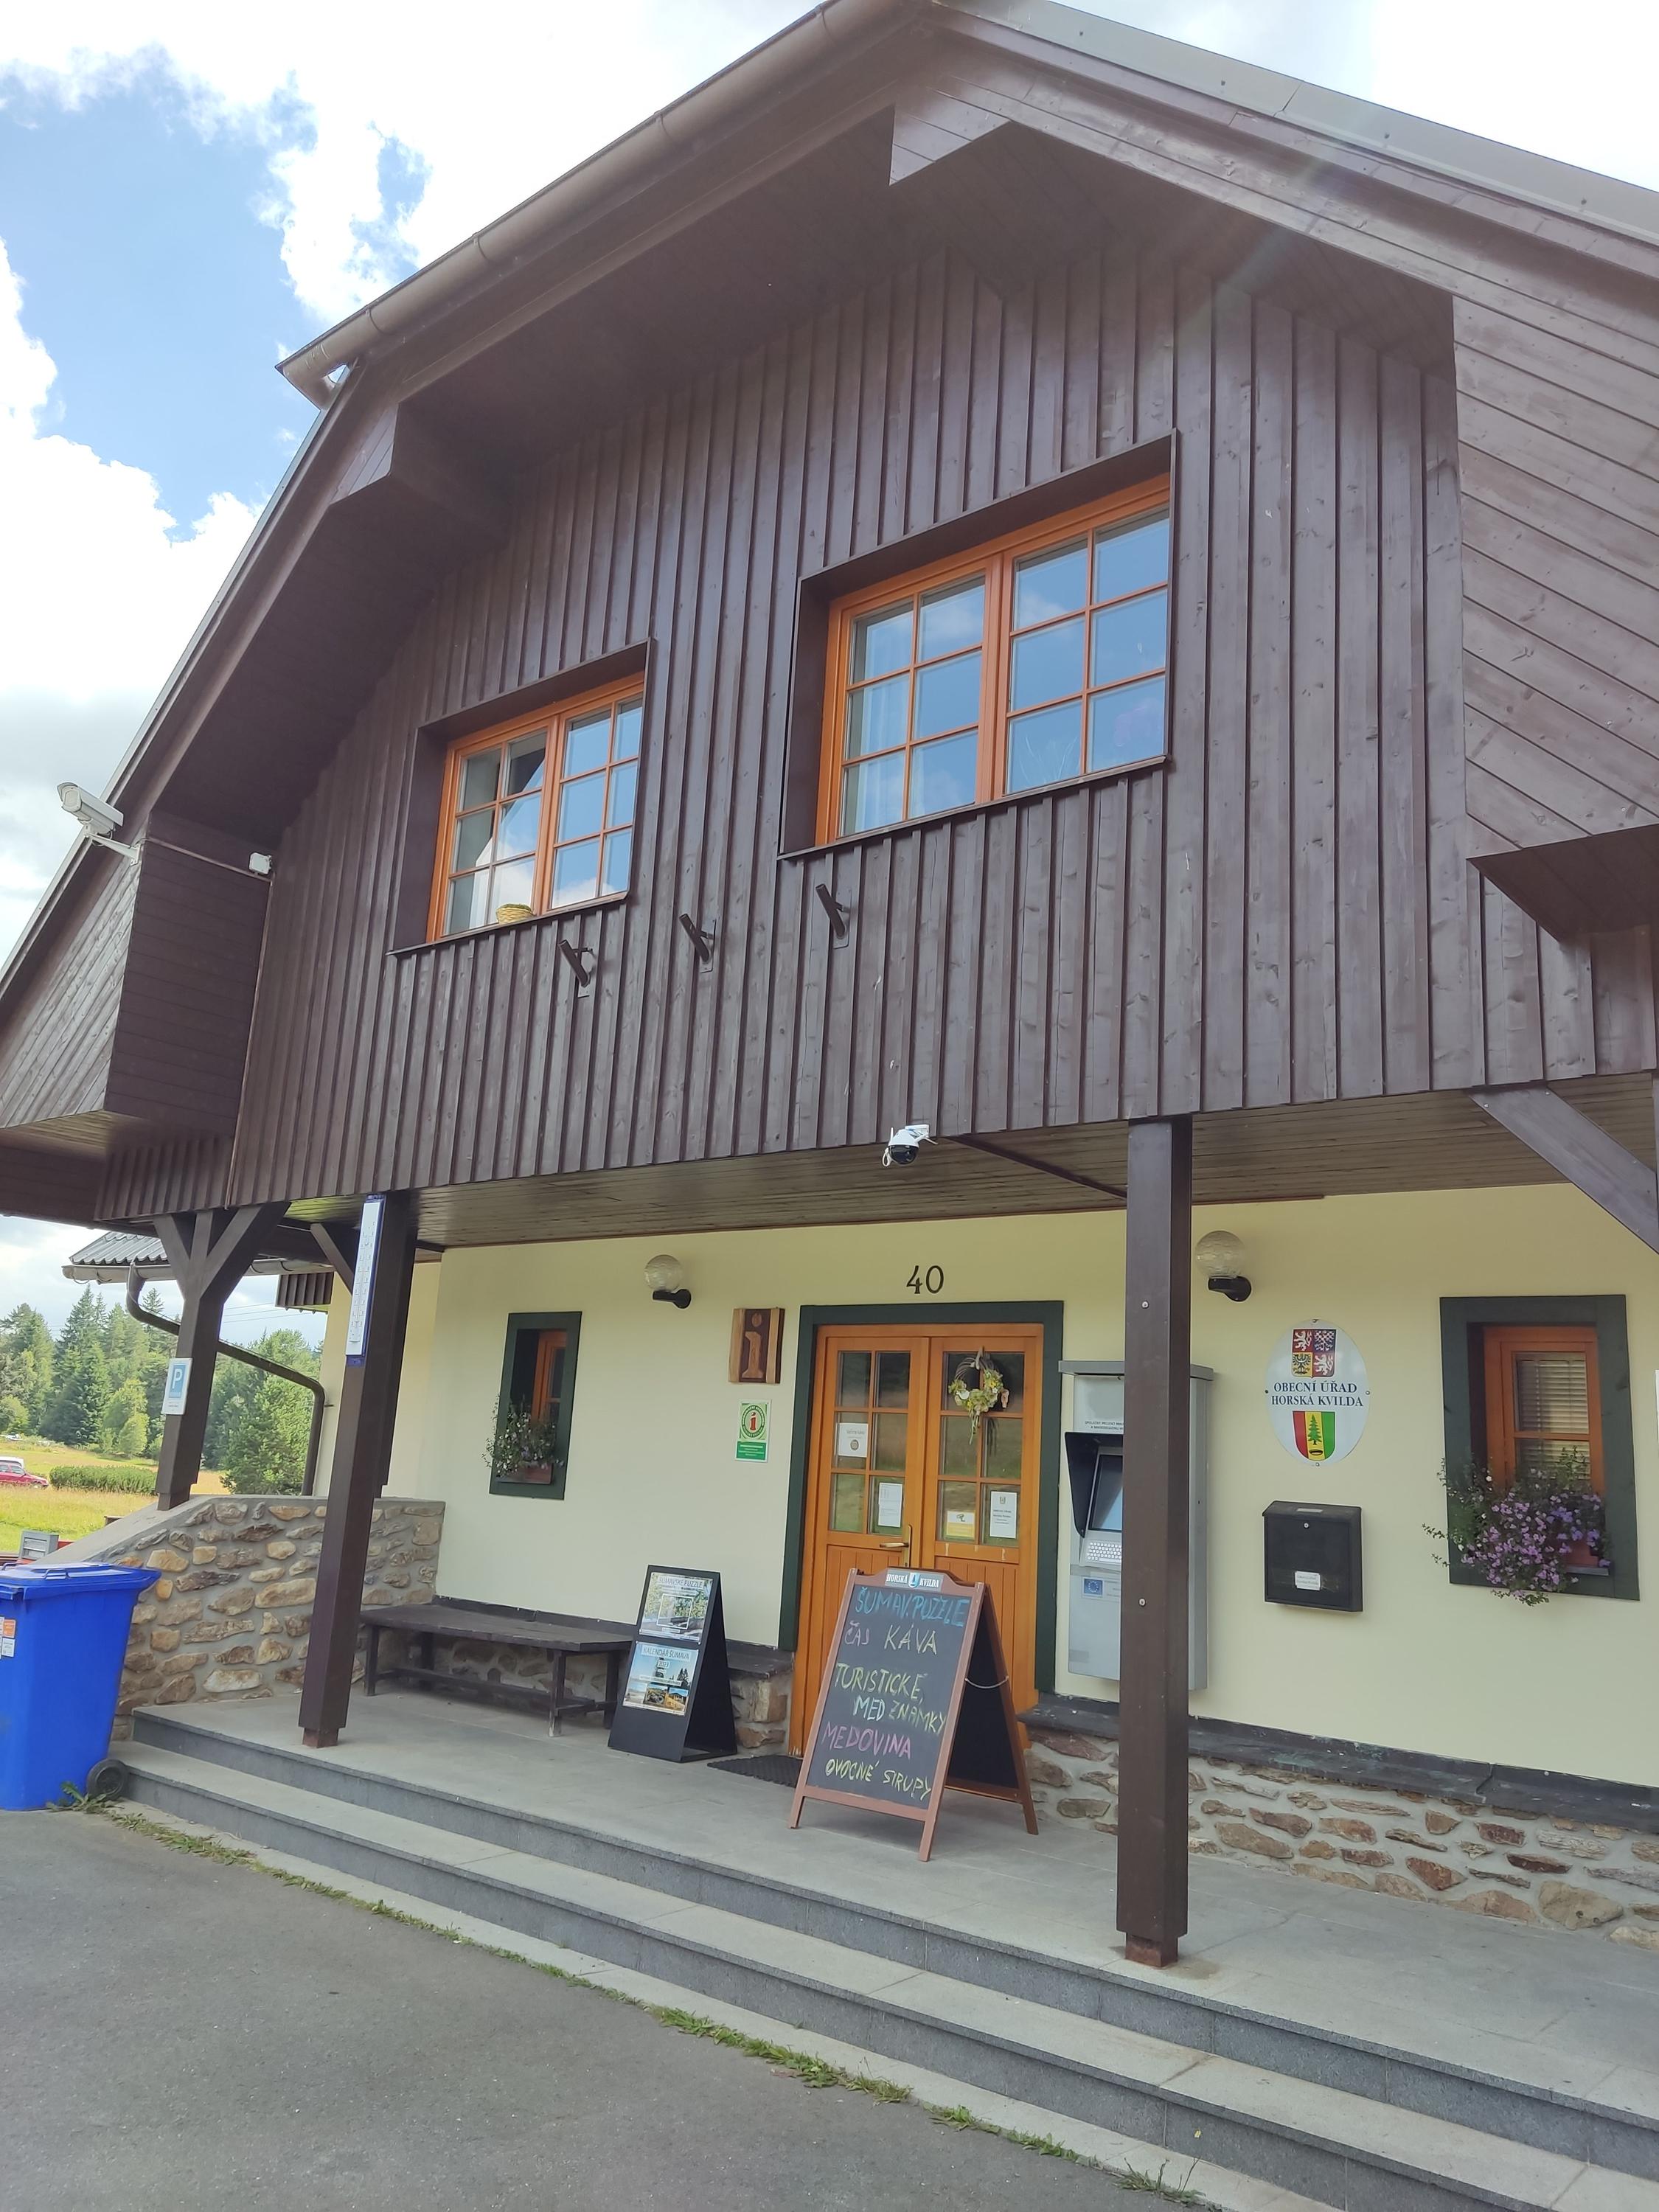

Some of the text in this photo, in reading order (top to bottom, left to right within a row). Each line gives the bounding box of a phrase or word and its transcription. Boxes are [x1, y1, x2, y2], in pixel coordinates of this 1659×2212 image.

[906, 1265, 944, 1294] 40
[172, 1368, 183, 1390] P
[1273, 1380, 1357, 1394] OBECNÍ ÚŘAD
[1271, 1394, 1364, 1407] HORSKÁ KVILDA
[684, 1579, 703, 1589] PUZZLE
[919, 1578, 940, 1588] KVILDA
[844, 1620, 938, 1655] ČAJ KÁVA
[852, 1695, 886, 1722] MED
[821, 1721, 911, 1760] MEDOVINA
[825, 1759, 932, 1801] OVOCNÉ SIRUPY
